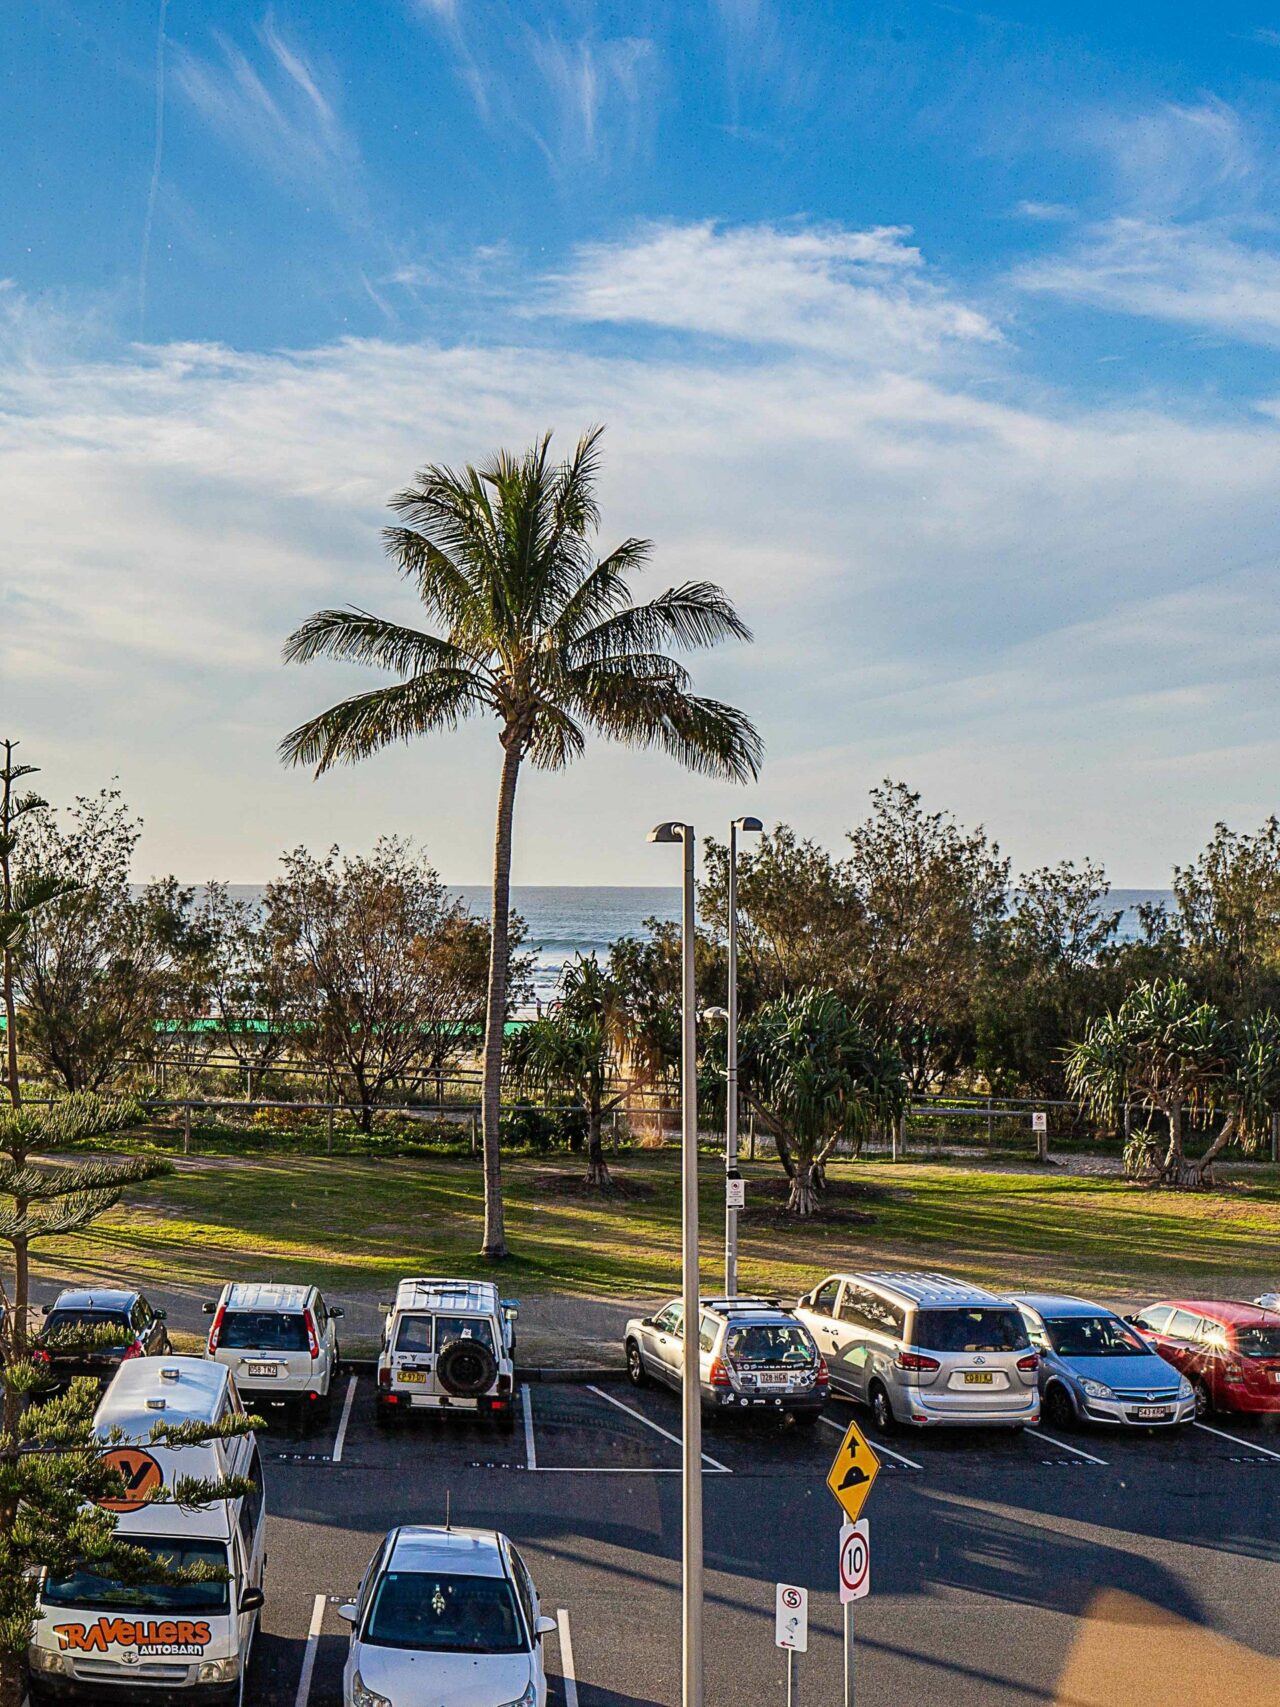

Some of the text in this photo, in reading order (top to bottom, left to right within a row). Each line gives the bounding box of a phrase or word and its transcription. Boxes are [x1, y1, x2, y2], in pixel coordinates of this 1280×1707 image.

[848, 1546, 863, 1576] 10
[53, 1617, 212, 1652] TRAVELLERS
[138, 1645, 204, 1656] AUTOBARN
